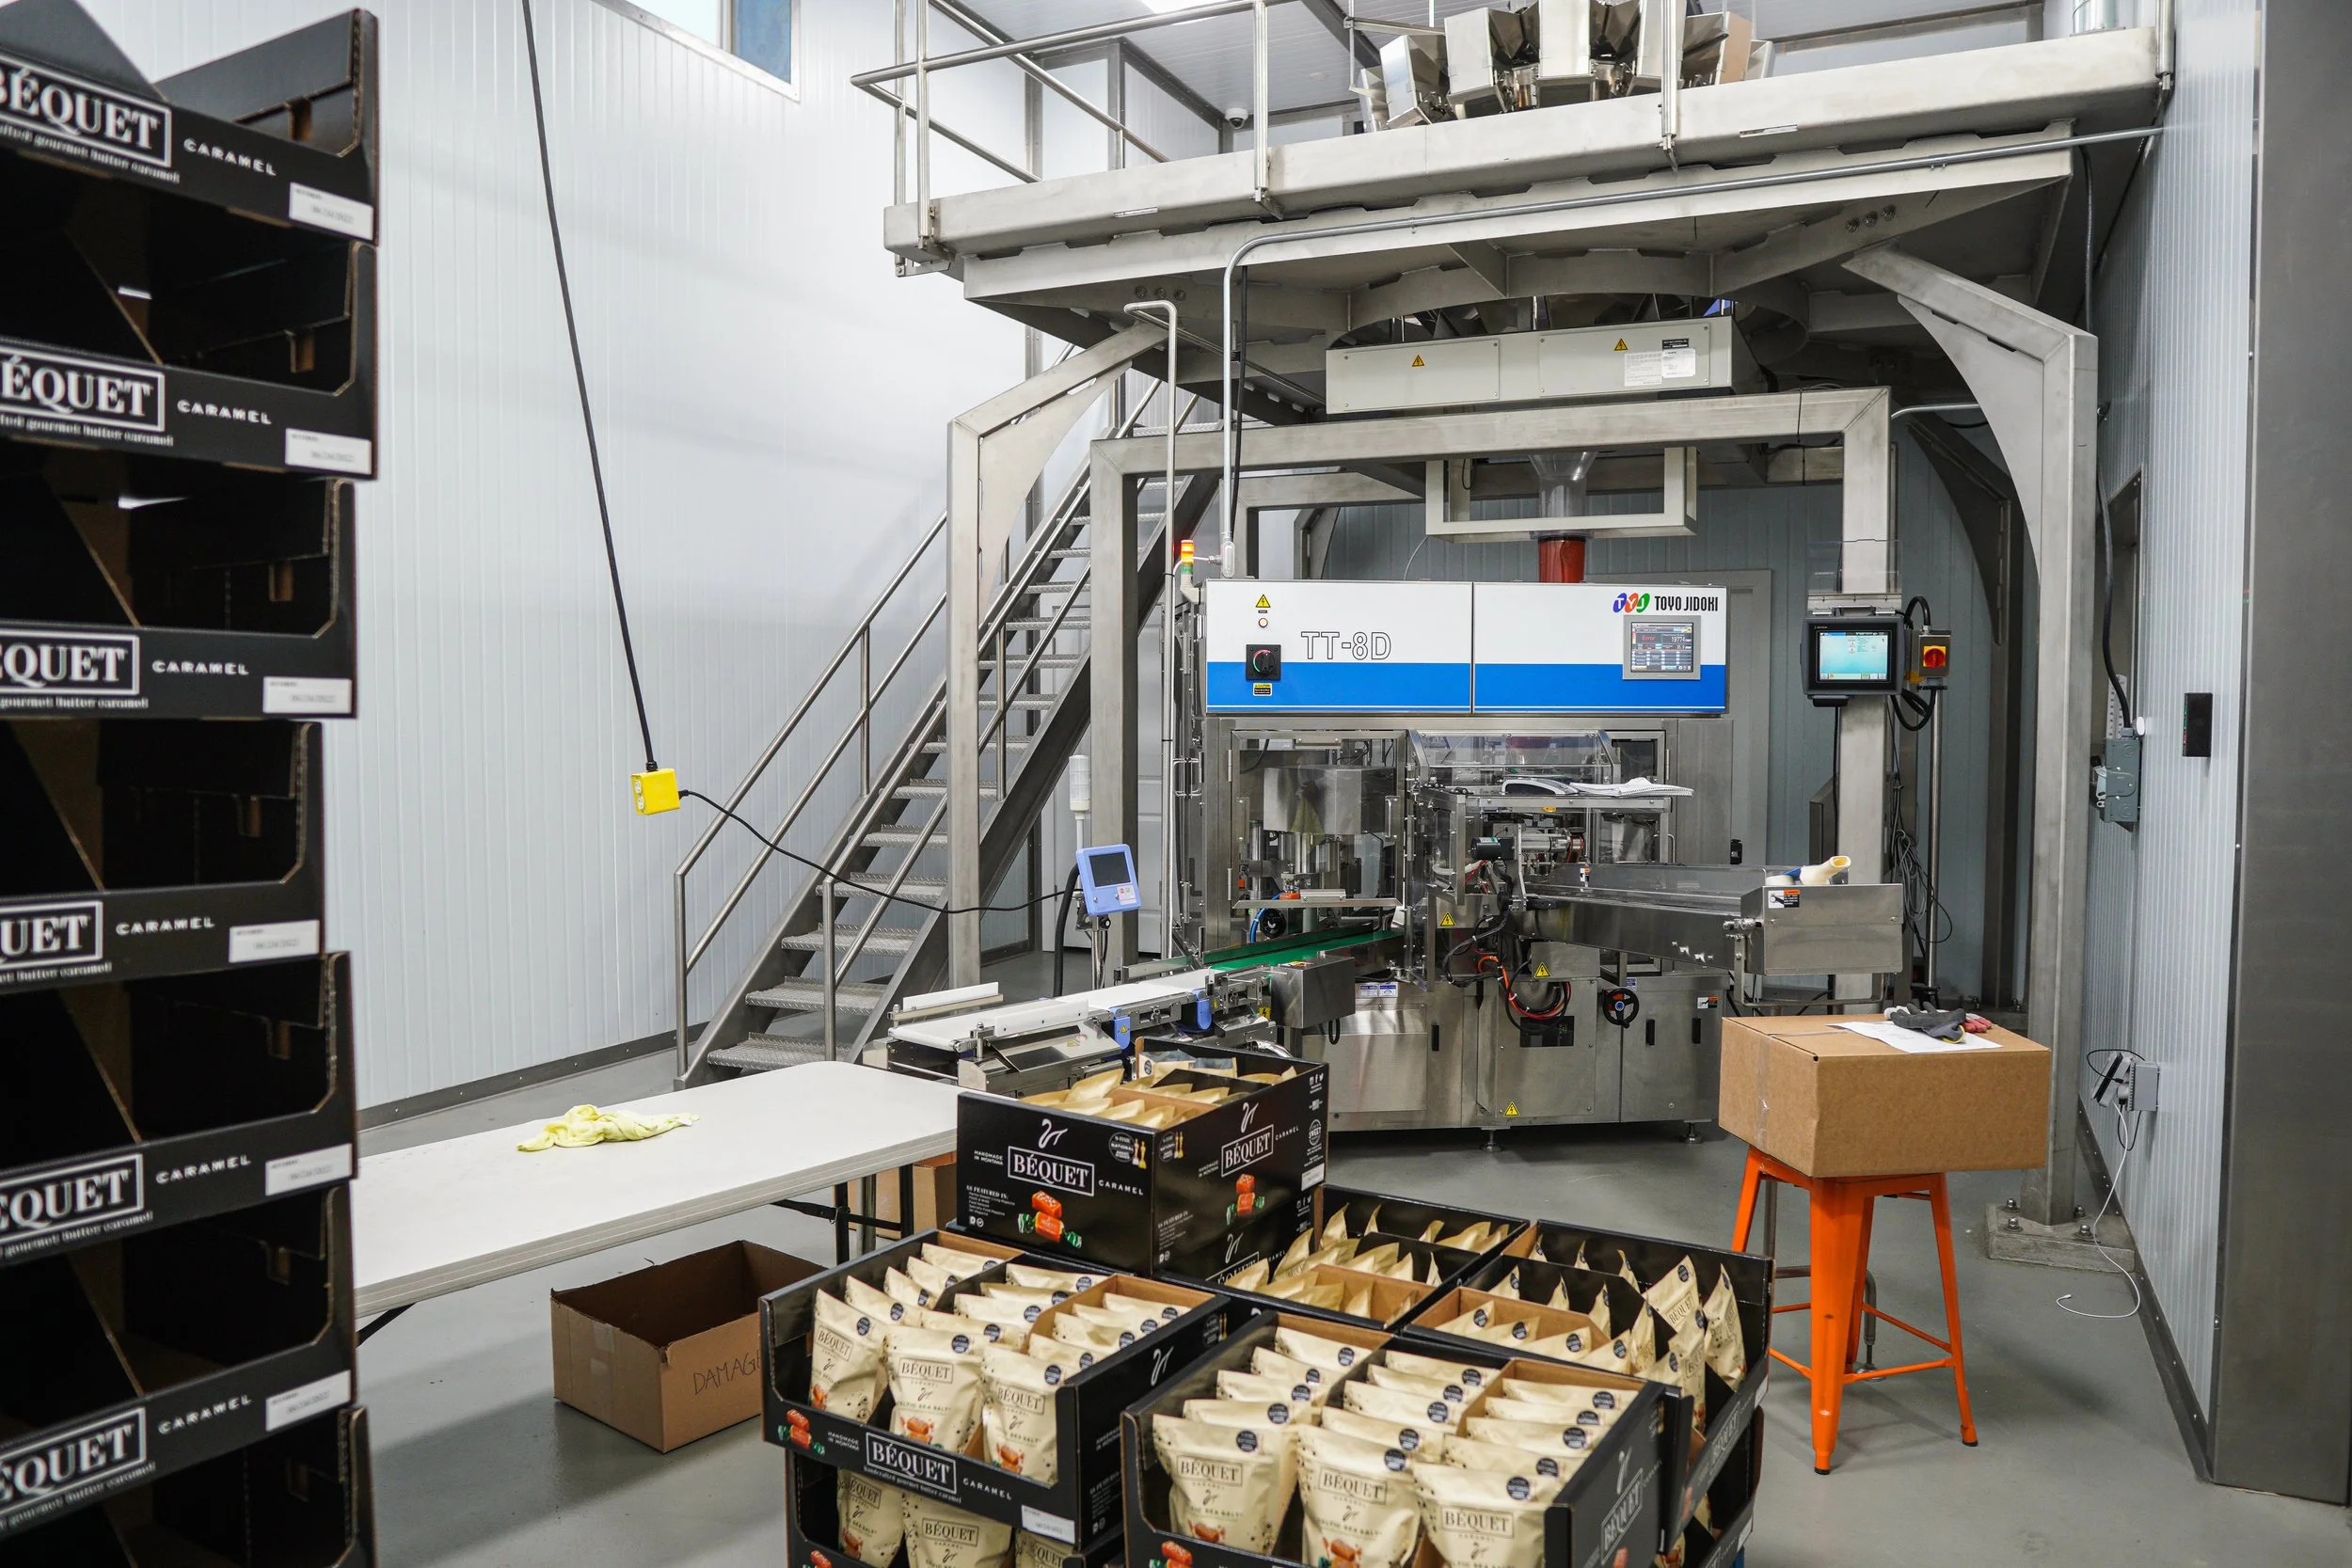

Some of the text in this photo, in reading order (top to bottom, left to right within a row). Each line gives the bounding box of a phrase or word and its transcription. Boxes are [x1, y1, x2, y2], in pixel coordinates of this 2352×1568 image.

[0, 66, 160, 150] ÉQUET
[183, 138, 277, 176] CARAMEL
[176, 399, 272, 425] CARAMEL
[1654, 596, 1719, 612] TOYO JIDOKI
[1301, 631, 1391, 660] TT-8D
[0, 641, 128, 689] QUET
[151, 660, 249, 675] CARAMEL
[116, 917, 215, 936] CARAMEL
[0, 914, 91, 963] UET
[1275, 1125, 1299, 1141] CARAMEL
[974, 1149, 1004, 1161] HANDMADE
[980, 1157, 1004, 1166] MONTANA
[1225, 1132, 1271, 1169] BÉQUET
[156, 1154, 251, 1184] CARAMEL
[1013, 1153, 1089, 1188] BÉQUET
[974, 1186, 1000, 1197] FEATURED
[1098, 1180, 1144, 1196] CARAMEL
[818, 1330, 850, 1356] BÉQUET
[901, 1360, 951, 1381] BÉQUET
[157, 1394, 253, 1434] CARAMEL
[828, 1431, 860, 1446] HANDMADE
[834, 1439, 860, 1452] MONTANA
[872, 1441, 950, 1484] BÉQUET
[1181, 1459, 1239, 1481] BÉQUET
[849, 1480, 880, 1503] ÉQUET
[962, 1478, 1012, 1501] CARAMEL
[1324, 1471, 1383, 1498] BÉQUET
[925, 1520, 975, 1542] BÉQUET
[1445, 1509, 1509, 1533] BÉQUET
[1034, 1546, 1063, 1568] QUET
